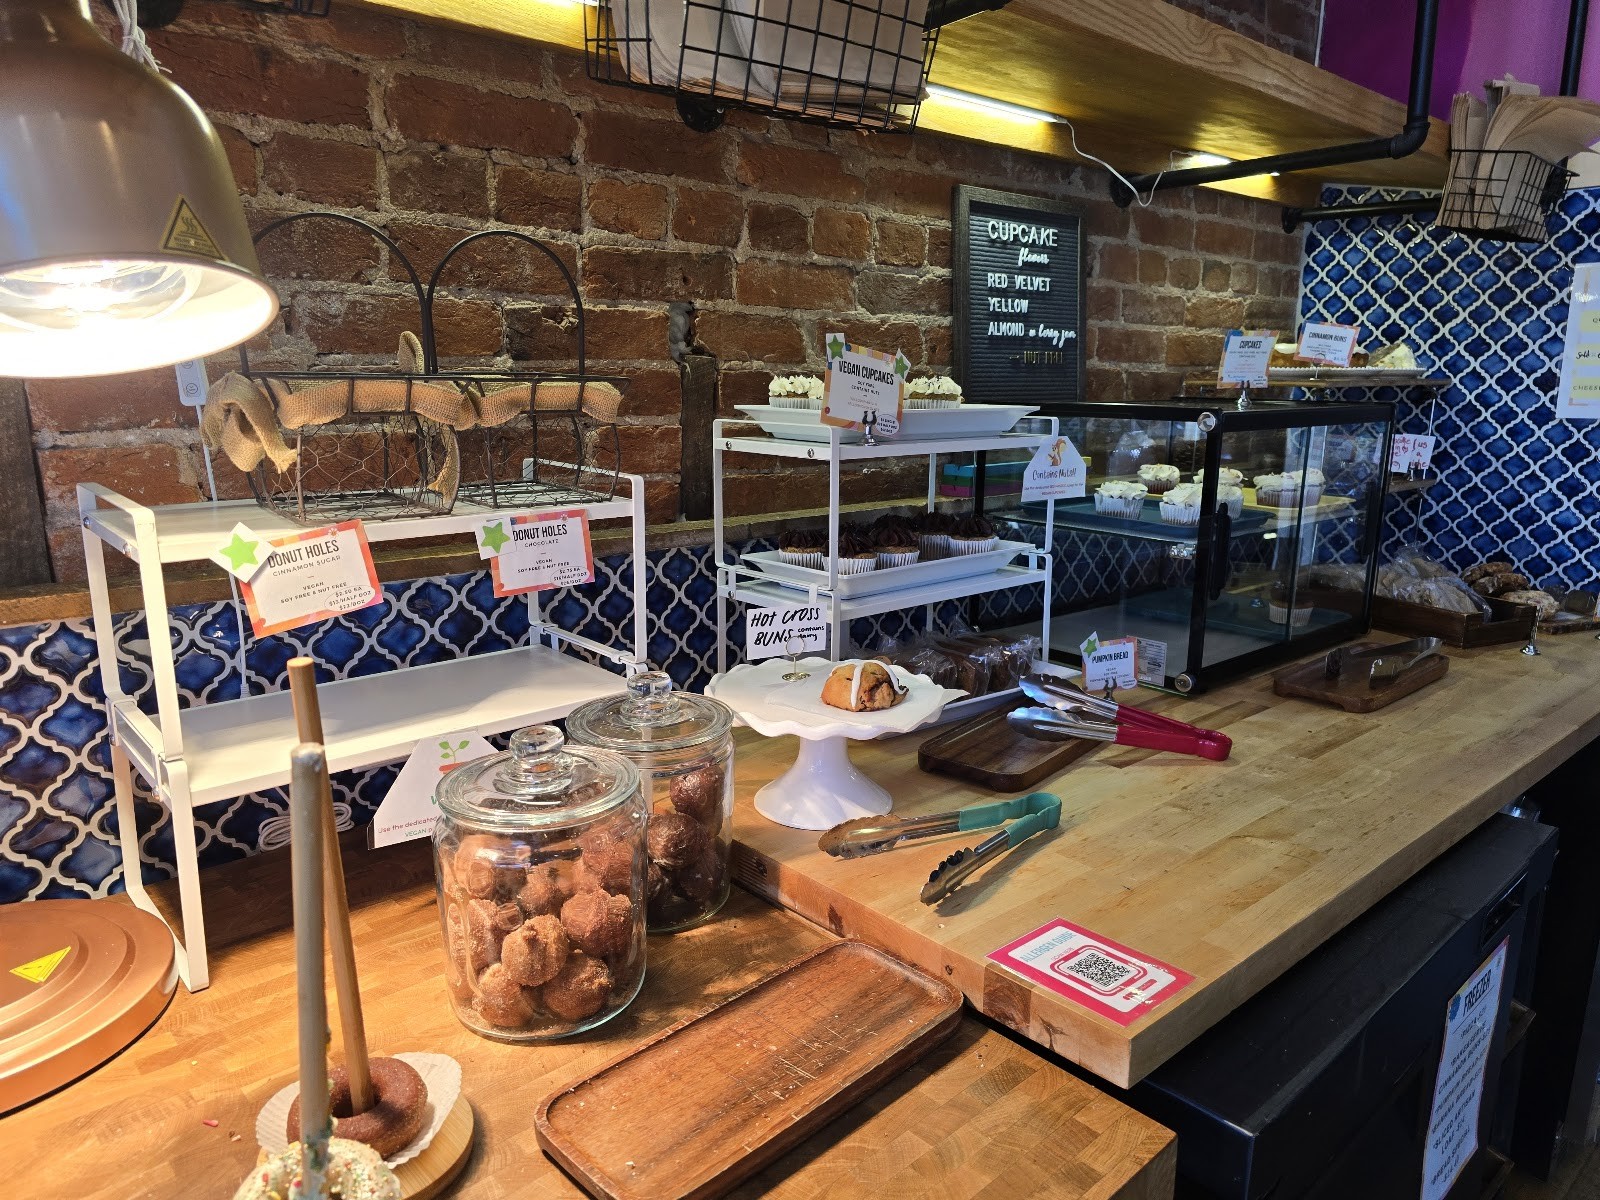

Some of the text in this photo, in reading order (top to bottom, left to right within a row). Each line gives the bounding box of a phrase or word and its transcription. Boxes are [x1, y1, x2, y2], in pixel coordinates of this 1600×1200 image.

[988, 221, 1058, 247] CUPCAKE
[988, 273, 1051, 292] RED VELVET
[988, 297, 1029, 314] YELLOW
[988, 322, 1024, 336] ALMOND
[1239, 341, 1262, 349] CUPCAKES
[838, 361, 894, 385] VEGAN CUPCAKES
[1033, 470, 1057, 480] Contains
[513, 524, 567, 541] DONUT HOLES
[524, 539, 559, 548] CHOCOLATE
[267, 540, 339, 568] DONUT HOLES
[273, 555, 340, 576] CINNAMON SUGAR
[302, 582, 324, 590] VEGAN
[751, 608, 820, 627] HOT CROSS
[754, 629, 793, 646] BUNS
[1092, 651, 1128, 664] PUMPKIN BREAD
[405, 816, 437, 828] dedicated
[405, 828, 426, 837] VEGAN
[1020, 931, 1077, 962] ALLERGEN GUIDE
[1463, 969, 1491, 1017] FREEZER
